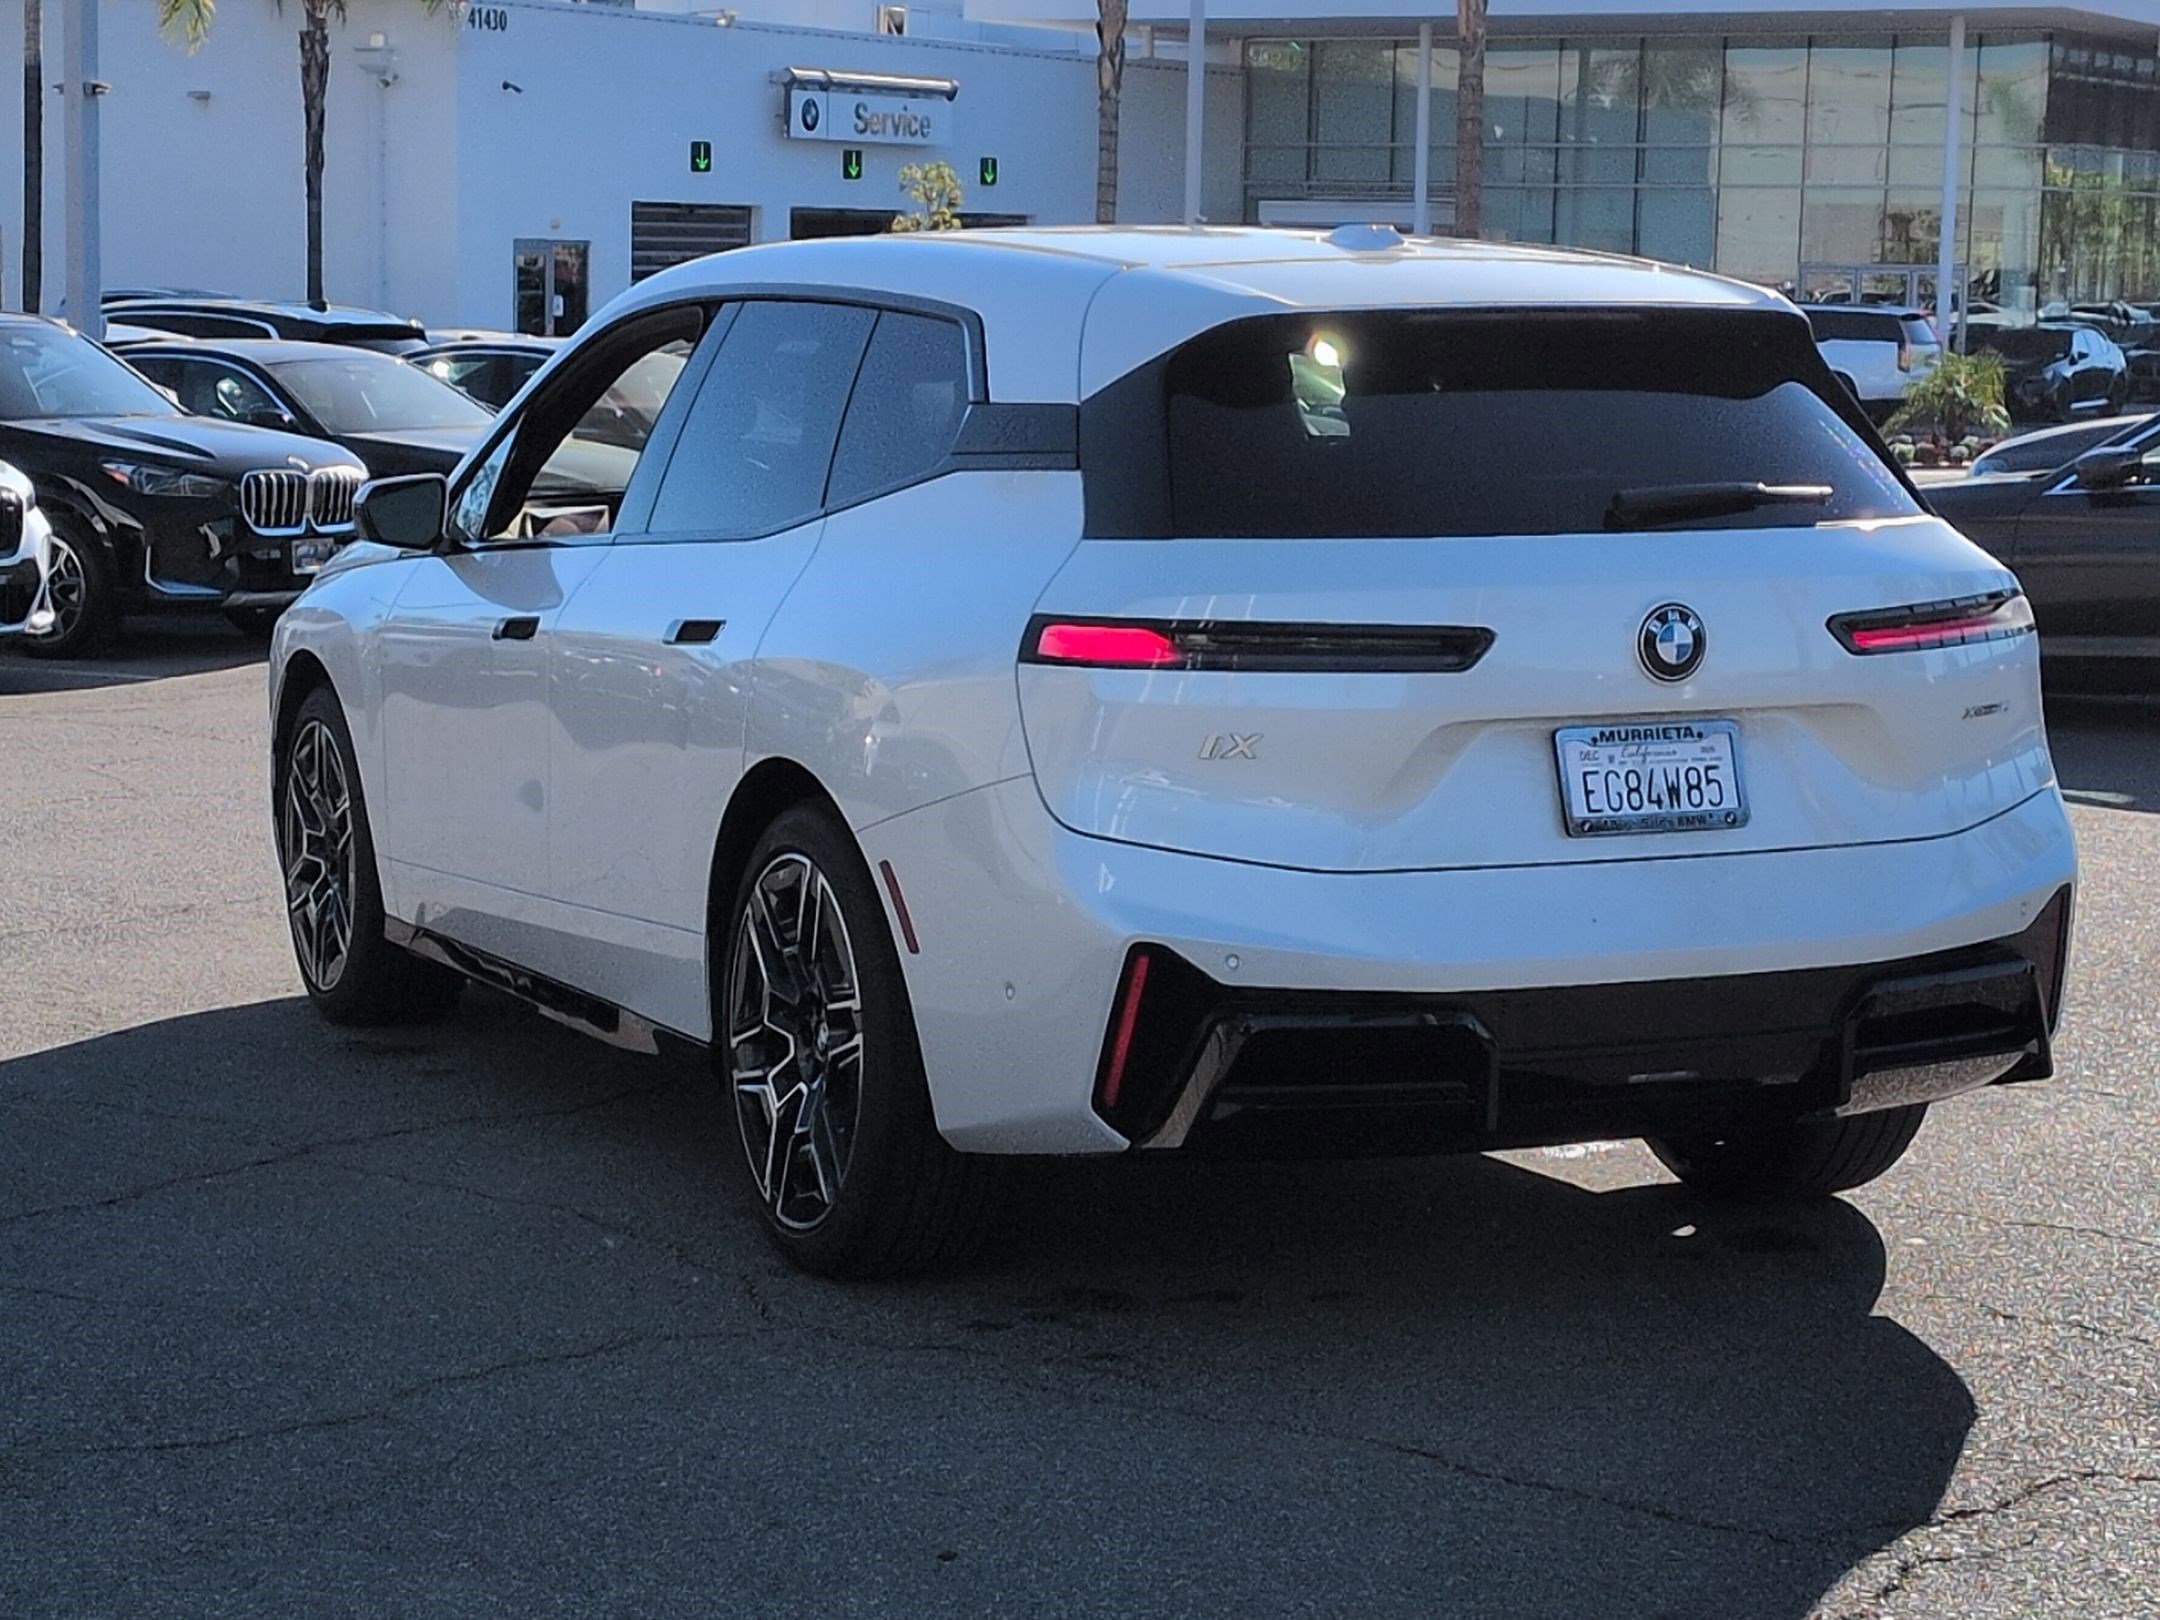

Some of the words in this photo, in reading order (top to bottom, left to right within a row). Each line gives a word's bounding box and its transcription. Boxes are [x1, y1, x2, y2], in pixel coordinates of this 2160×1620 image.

[468, 7, 508, 31] 41430
[853, 102, 931, 138] Service
[1599, 726, 1694, 743] MURRIETA
[1582, 765, 1724, 813] EG84W85
